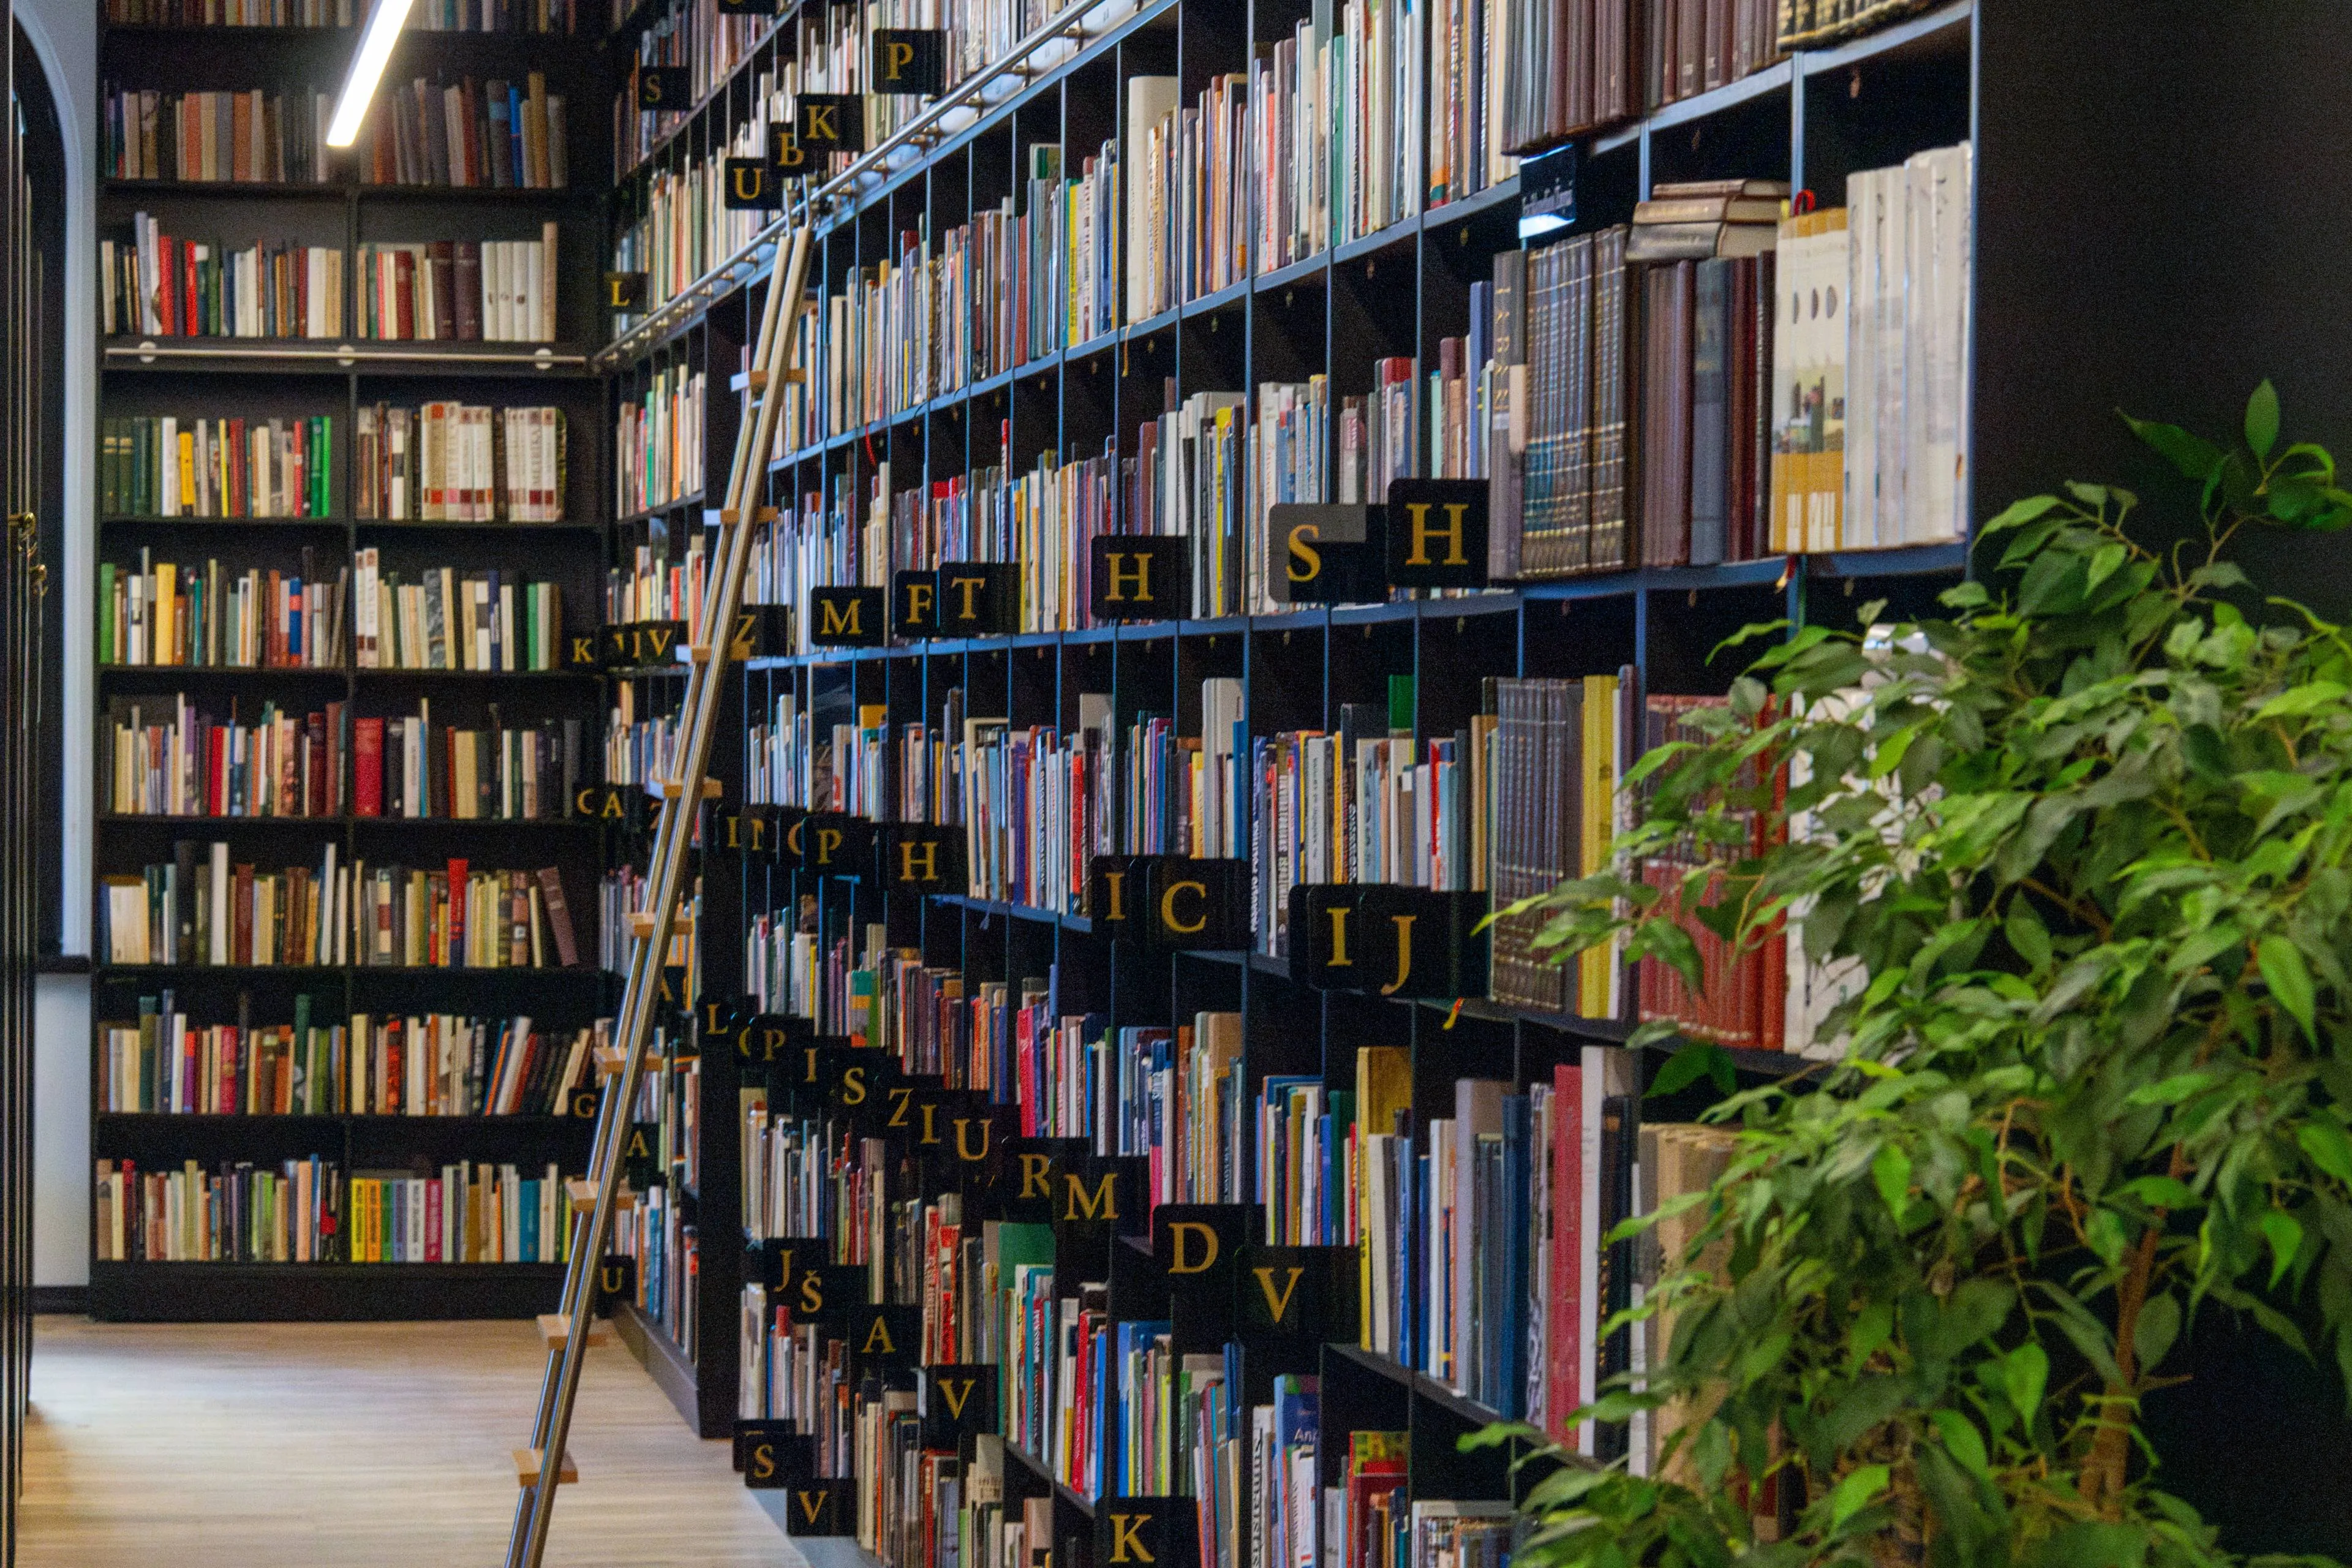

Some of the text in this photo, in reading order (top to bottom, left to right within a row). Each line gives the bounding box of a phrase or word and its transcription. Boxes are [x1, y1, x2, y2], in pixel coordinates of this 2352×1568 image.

[886, 43, 914, 80] P
[645, 75, 661, 103] S
[805, 105, 838, 140] K
[734, 168, 763, 200] U
[611, 280, 630, 307] L
[1286, 524, 1321, 582] S
[1406, 503, 1469, 565] H
[1104, 552, 1153, 601] H
[820, 598, 863, 636] M
[906, 584, 933, 624] F
[951, 577, 986, 619] T
[572, 637, 593, 663] K
[647, 629, 672, 657] V
[577, 788, 595, 815] C
[601, 791, 624, 818] A
[817, 829, 843, 864] P
[900, 841, 940, 881] H
[1104, 873, 1126, 921] I
[1161, 881, 1207, 933] C
[1326, 907, 1352, 967] I
[1381, 915, 1417, 996] J
[706, 1003, 728, 1035] L
[764, 1029, 786, 1061] P
[574, 1093, 597, 1118] G
[844, 1067, 866, 1106] S
[888, 1088, 913, 1126] Z
[627, 1130, 649, 1157] A
[953, 1118, 992, 1161] U
[1018, 1153, 1050, 1198] R
[1063, 1173, 1120, 1220] M
[1168, 1223, 1219, 1274] D
[602, 1267, 624, 1293] U
[774, 1249, 792, 1292] J
[801, 1270, 823, 1313] Š
[1253, 1267, 1303, 1323] V
[861, 1316, 897, 1353] A
[938, 1379, 975, 1420] V
[754, 1444, 775, 1478] S
[798, 1491, 827, 1525] V
[1110, 1514, 1155, 1563] K
